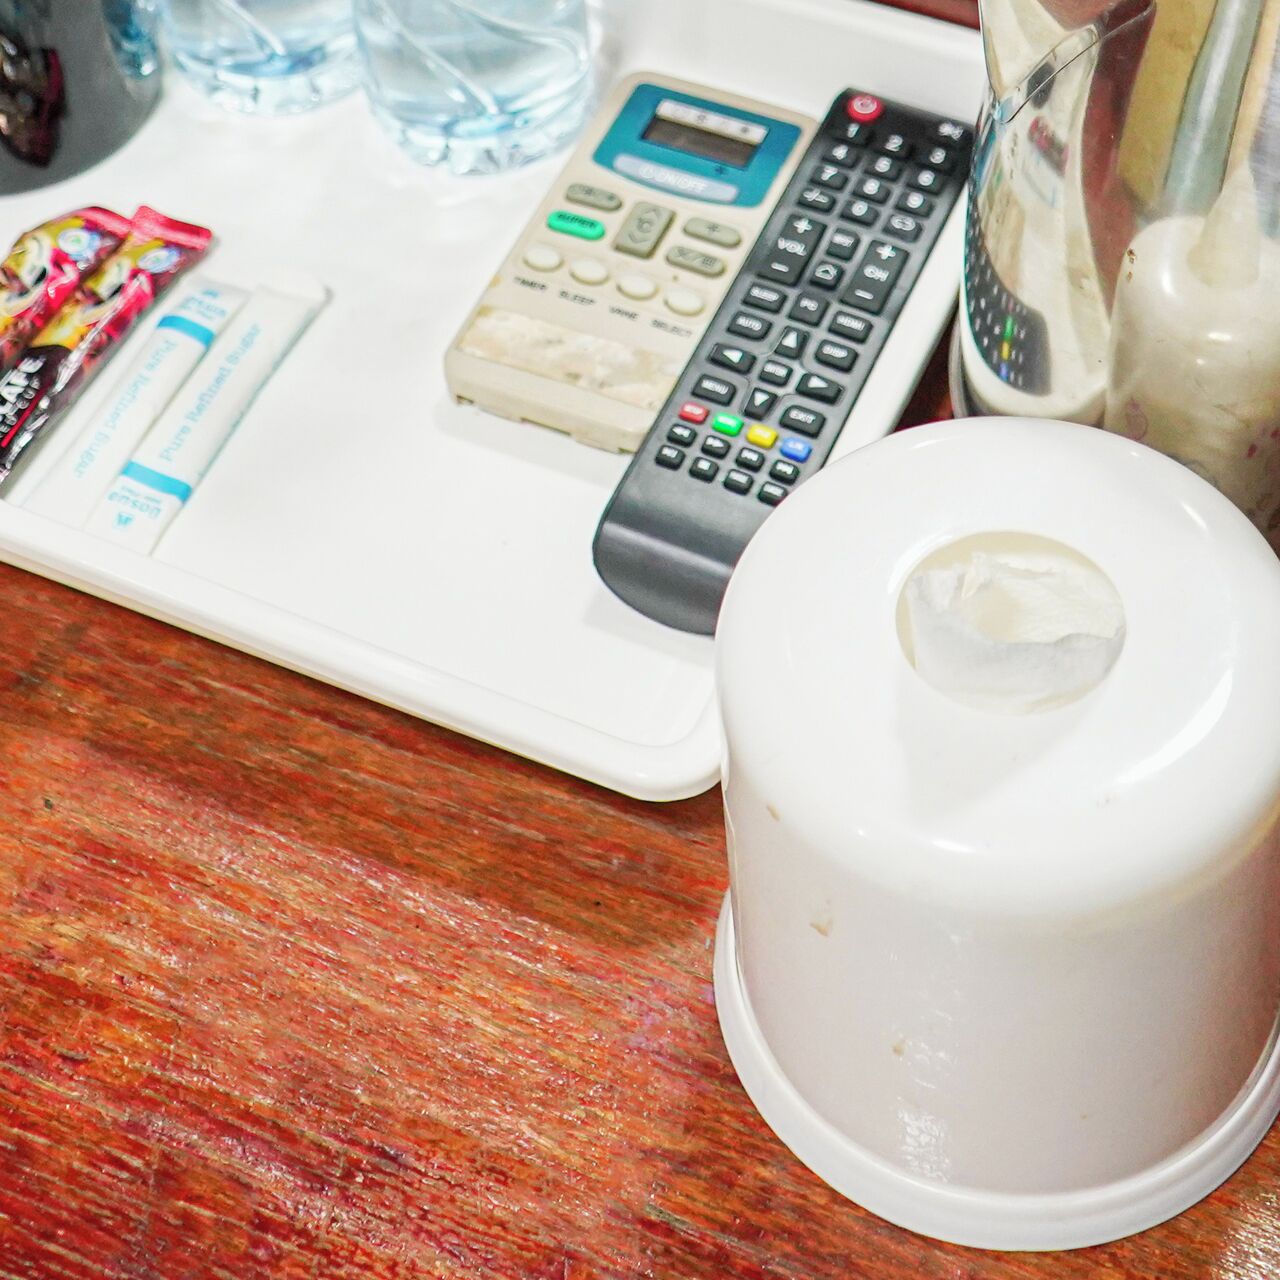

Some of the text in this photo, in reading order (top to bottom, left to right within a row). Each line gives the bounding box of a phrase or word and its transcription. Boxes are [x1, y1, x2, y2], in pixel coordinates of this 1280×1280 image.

[847, 123, 860, 138] 1
[885, 134, 903, 152] 2
[832, 145, 849, 160] 4
[821, 165, 838, 181] 7
[863, 178, 880, 195] 8
[778, 237, 807, 257] VOL
[160, 322, 262, 462] Pure Refined Sugar
